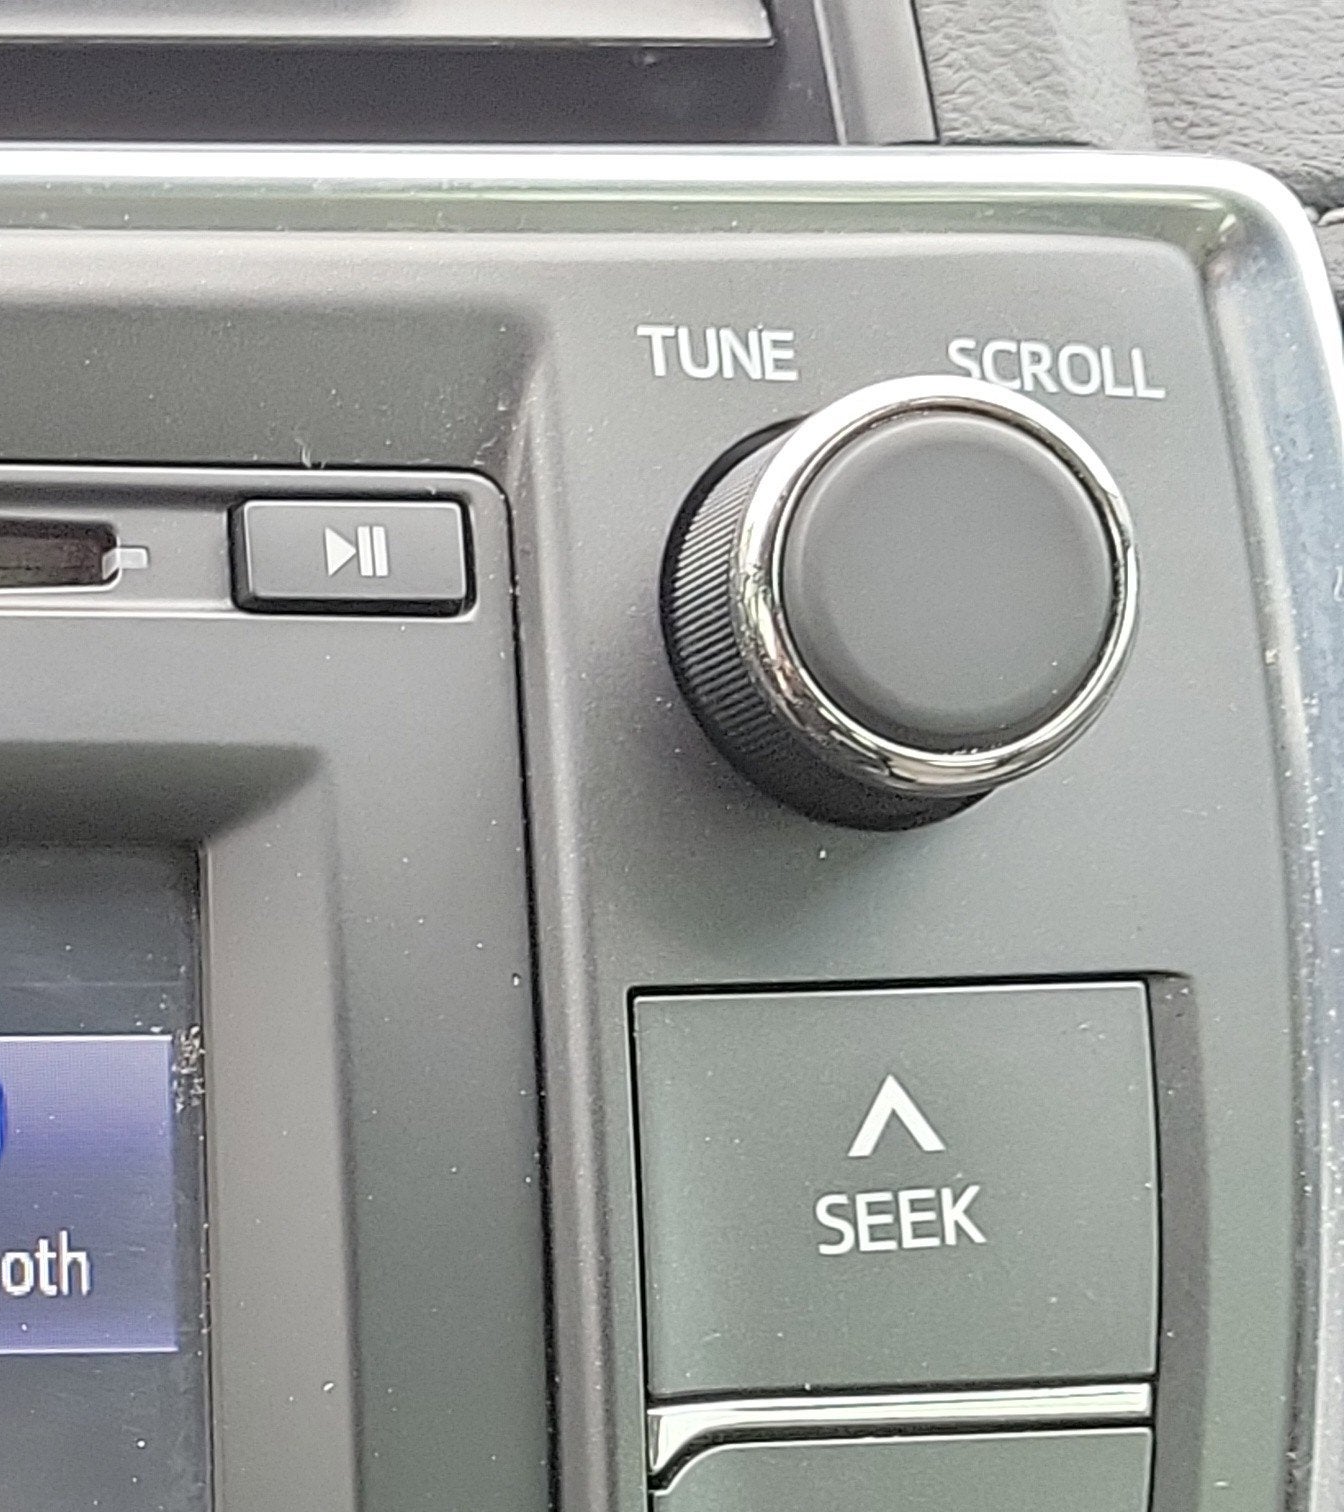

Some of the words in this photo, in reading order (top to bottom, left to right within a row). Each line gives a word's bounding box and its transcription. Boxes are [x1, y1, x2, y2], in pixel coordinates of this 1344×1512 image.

[637, 324, 799, 381] TUNE
[947, 338, 1166, 400] SCROLL
[814, 1184, 986, 1255] SEEK
